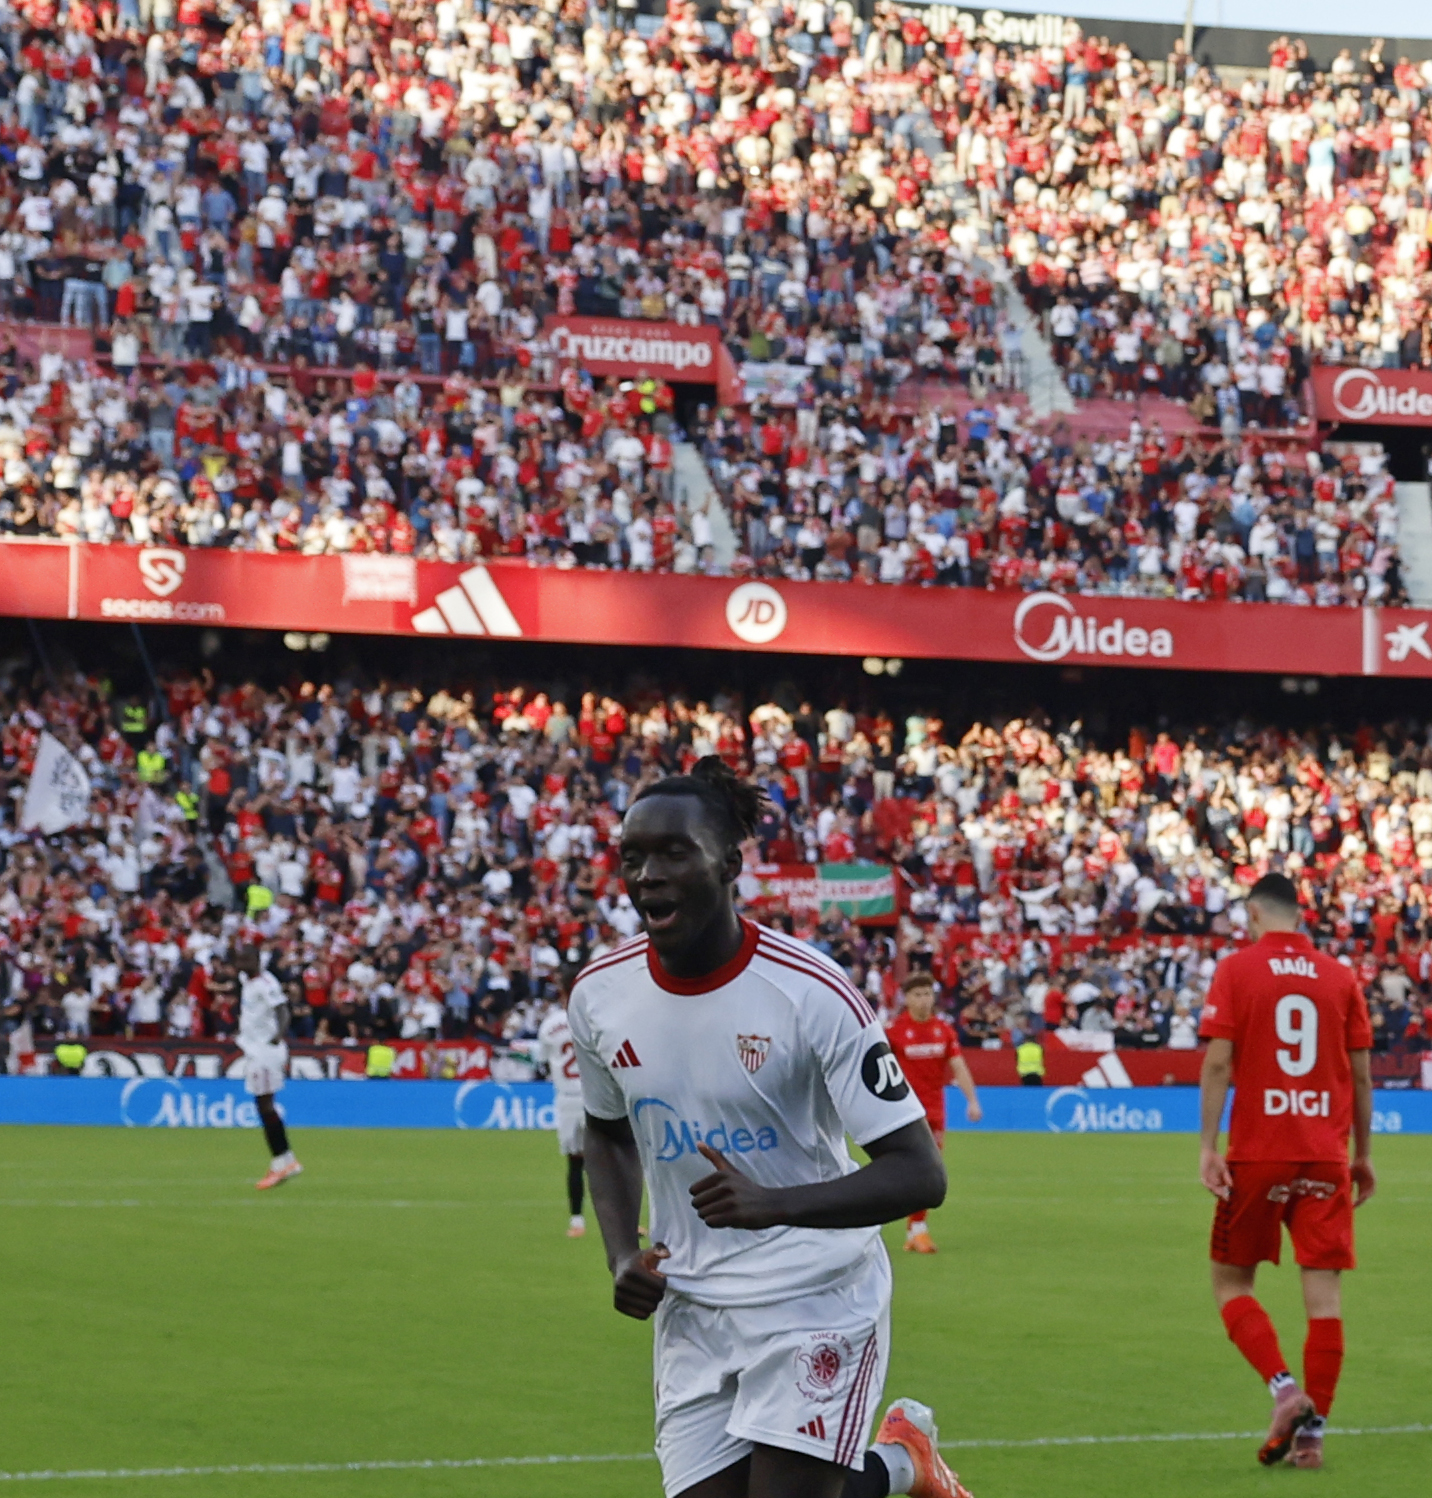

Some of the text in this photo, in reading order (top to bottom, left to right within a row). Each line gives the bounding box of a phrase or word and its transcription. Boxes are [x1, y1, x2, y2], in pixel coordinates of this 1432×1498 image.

[550, 325, 713, 371] Cruzcampo
[737, 599, 776, 625] JD
[1039, 612, 1173, 661] Midea
[1267, 956, 1319, 979] RAÚL
[1275, 994, 1318, 1077] 9
[873, 1052, 904, 1095] JD
[1069, 1101, 1163, 1133] Midea
[1263, 1089, 1330, 1117] DIGI
[656, 1119, 778, 1163] Midea
